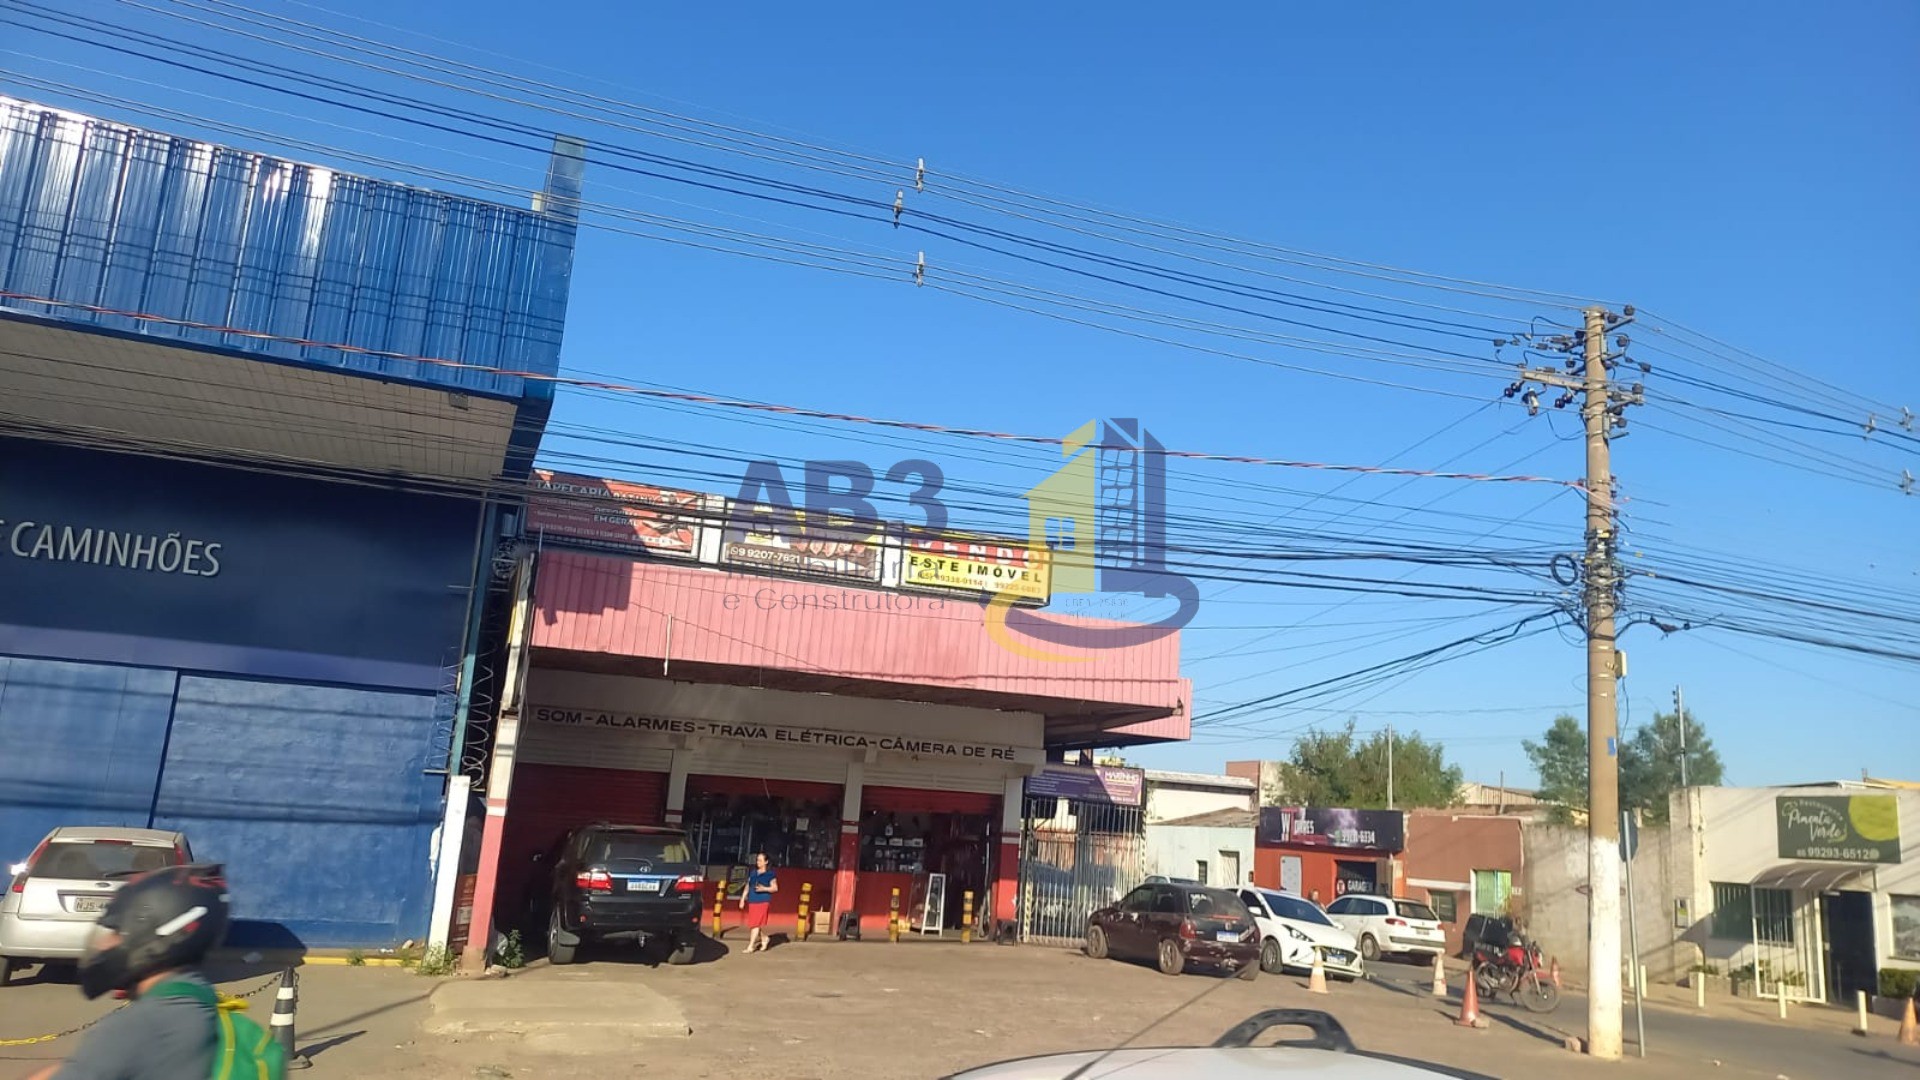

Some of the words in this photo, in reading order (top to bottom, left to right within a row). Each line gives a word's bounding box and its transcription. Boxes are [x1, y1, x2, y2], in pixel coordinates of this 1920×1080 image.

[10, 521, 222, 577] CAMINHÕES
[912, 539, 1043, 570] VENDO
[910, 556, 959, 572] ESTE
[967, 563, 1042, 583] IMÓVEL
[963, 745, 986, 758] DE
[991, 745, 1016, 761] RÉ
